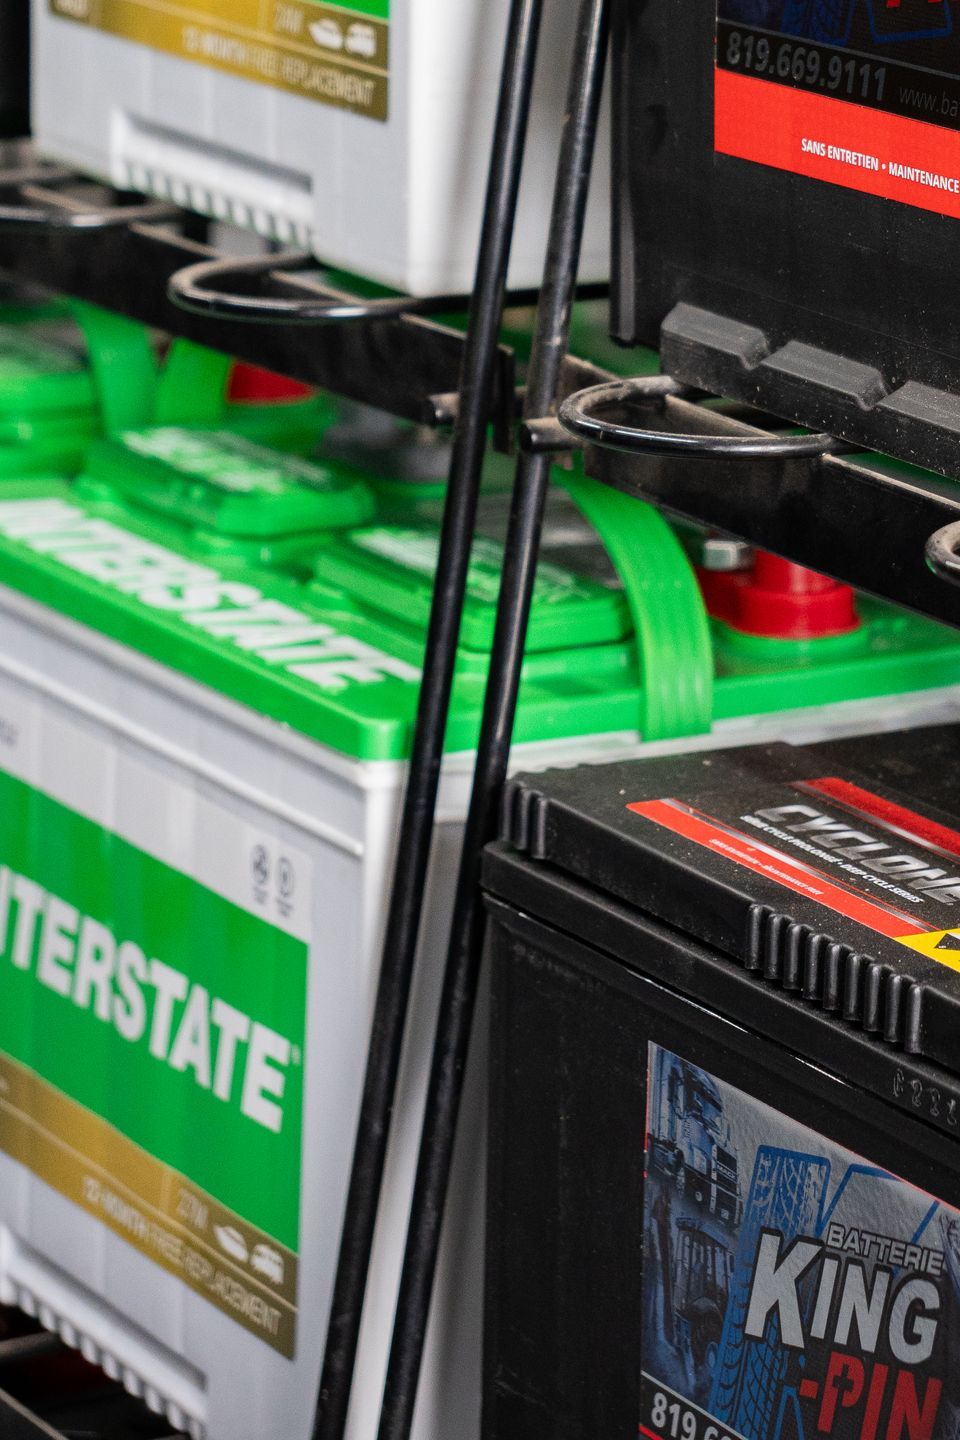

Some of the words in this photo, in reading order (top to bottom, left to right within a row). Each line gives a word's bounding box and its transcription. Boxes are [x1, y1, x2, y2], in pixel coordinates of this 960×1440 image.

[726, 31, 887, 102] 819.669.9111
[801, 137, 826, 158] SANS
[827, 144, 879, 171] ENTRETIEN
[888, 161, 960, 194] MAINTENANCE
[826, 1225, 945, 1277] BATTERIE
[744, 1233, 941, 1364] KING
